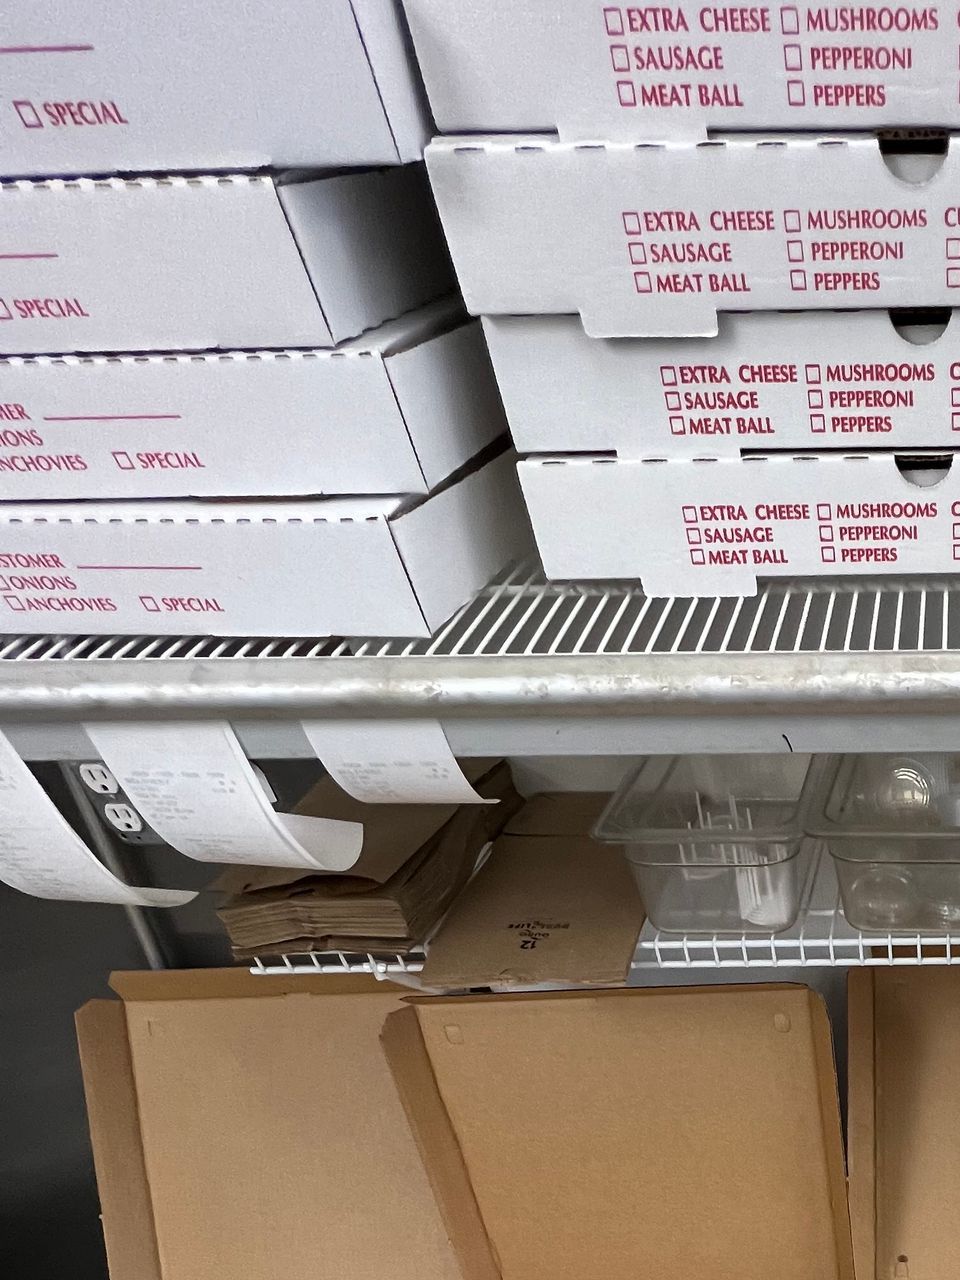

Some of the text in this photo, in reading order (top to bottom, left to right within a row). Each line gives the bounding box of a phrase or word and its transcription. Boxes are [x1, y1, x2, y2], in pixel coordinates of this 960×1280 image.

[627, 7, 770, 33] EXTRA CHEESE
[806, 7, 939, 32] MUSHROOMS
[634, 47, 723, 70] SAUSAGE
[810, 46, 913, 70] PEPPERONI
[641, 83, 744, 108] MEAT BALL
[813, 82, 887, 107] PEPPERS
[45, 103, 128, 125] SPECIAL
[643, 209, 774, 232] EXTRA CHEESE
[807, 208, 928, 229] MUSHROOMS
[651, 242, 732, 262] SAUSAGE
[811, 242, 904, 260] PEPPERONI
[656, 272, 751, 293] MEAT BALL
[814, 270, 881, 291] PEPPERS
[13, 298, 89, 318] SPECIAL
[678, 364, 798, 384] EXTRA CHEESE
[826, 363, 935, 382] MUSHROOMS
[684, 391, 759, 409] SAUSAGE
[829, 391, 915, 408] PEPPERONI
[689, 417, 774, 435] MEAT BALL
[831, 416, 893, 432] PEPPERS
[137, 452, 205, 469] SPECIAL
[699, 503, 810, 521] EXTRA CHEESE
[836, 502, 938, 519] MUSHROOMS
[703, 527, 773, 543] SAUSAGE
[840, 526, 919, 541] PEPPERONI
[708, 548, 789, 565] MEAT BALL
[841, 548, 898, 564] PEPPERS
[9, 576, 77, 590] ONIONS
[26, 597, 117, 612] ANCHOVIES
[161, 596, 224, 613] SPECIAL
[520, 939, 537, 950] 12
